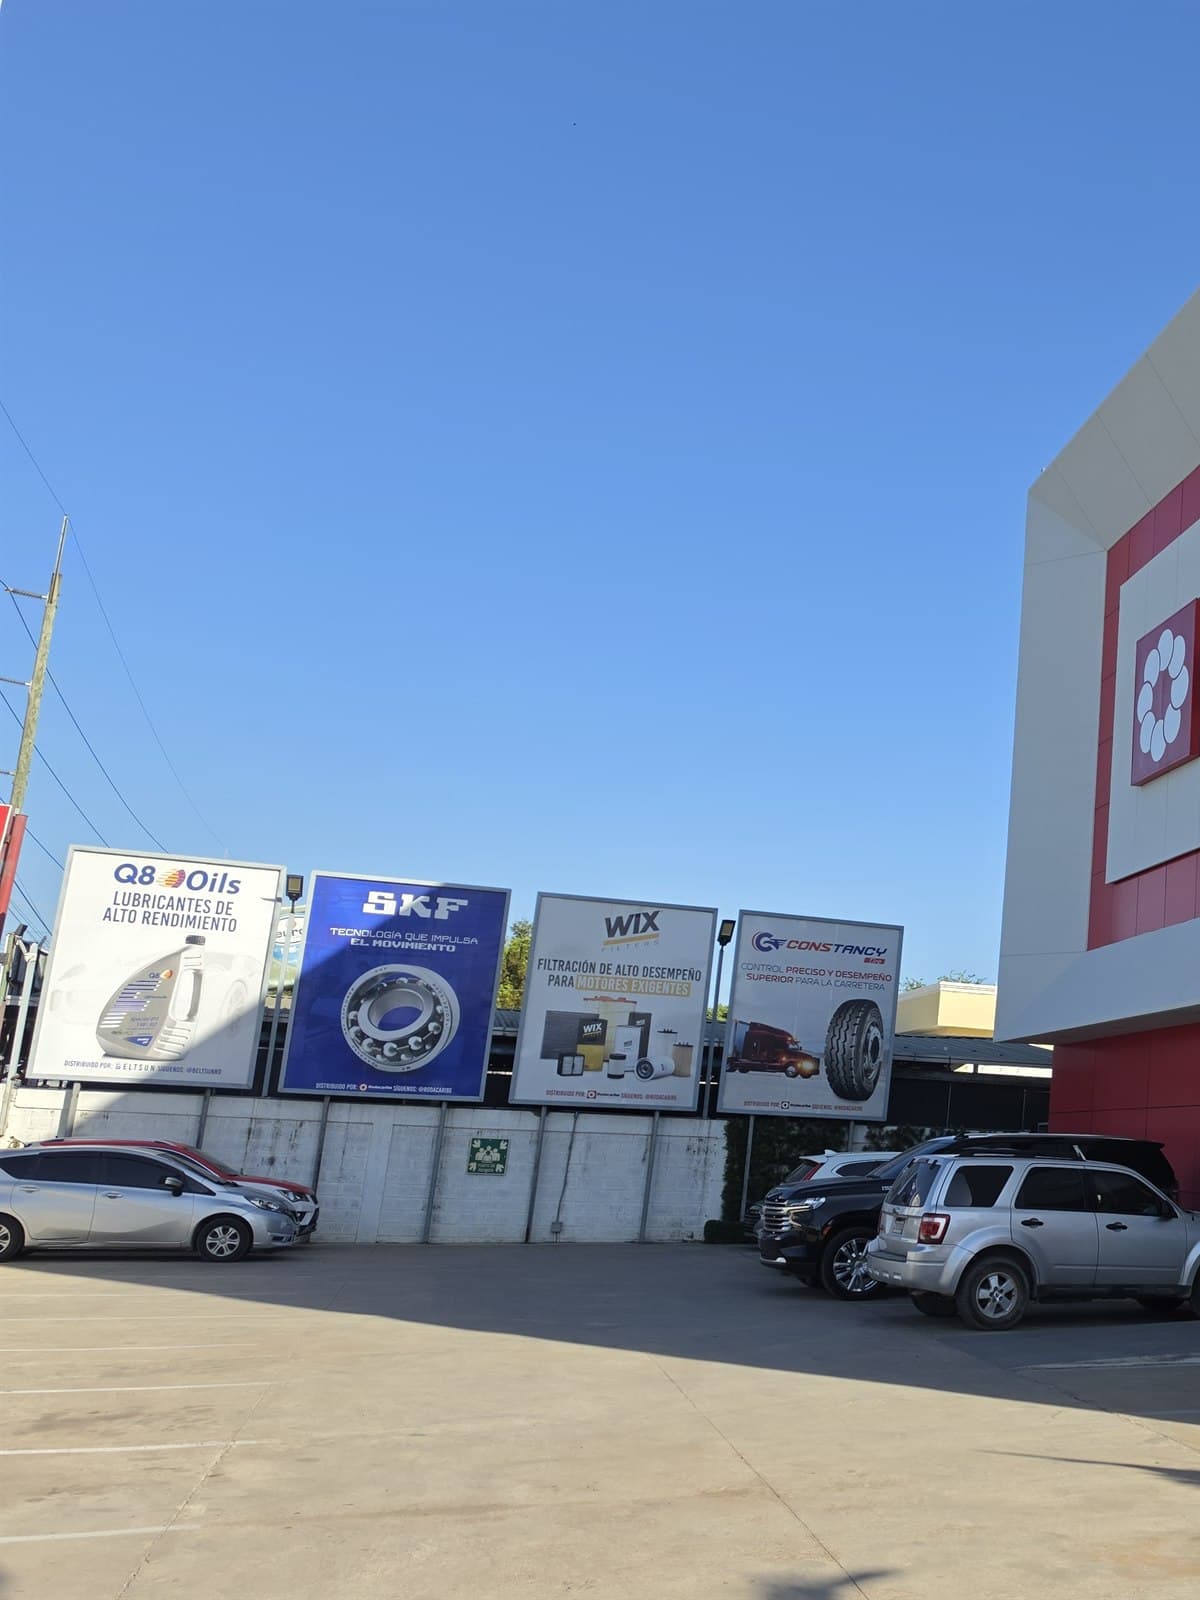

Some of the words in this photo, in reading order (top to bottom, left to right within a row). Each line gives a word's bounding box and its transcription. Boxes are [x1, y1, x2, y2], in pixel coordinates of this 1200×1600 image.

[114, 863, 156, 886] Q8
[186, 870, 242, 894] Oils
[113, 891, 212, 914] LUBRICANTES
[215, 900, 235, 916] DE
[362, 890, 469, 920] SKF
[102, 907, 137, 924] ALTO
[141, 910, 237, 933] RENDIMIENTO
[604, 910, 661, 938] WIX
[330, 927, 402, 940] TECNOLOGÍA
[405, 932, 428, 942] QUE
[431, 934, 478, 945] IMPULSA
[350, 938, 369, 947] EL
[372, 939, 456, 953] MOVIMIENTO
[786, 939, 888, 957] CONSTANCY
[537, 958, 596, 974] FILTRACIÓN
[600, 963, 612, 975] DE
[615, 964, 639, 977] ALTO
[642, 967, 702, 982] DESEMPEÑO
[741, 962, 784, 973] CONTROL
[786, 966, 826, 977] PRECISO
[827, 969, 834, 977] Y
[835, 970, 892, 982] DESEMPEÑO
[548, 974, 574, 988] PARA
[577, 977, 628, 992] MOTORES
[631, 980, 689, 996] EXIGENTES
[746, 973, 793, 984] SUPERIOR
[795, 976, 820, 986] PARA
[821, 978, 833, 987] LA
[834, 979, 885, 991] CARRETERA
[583, 1022, 602, 1033] WIX
